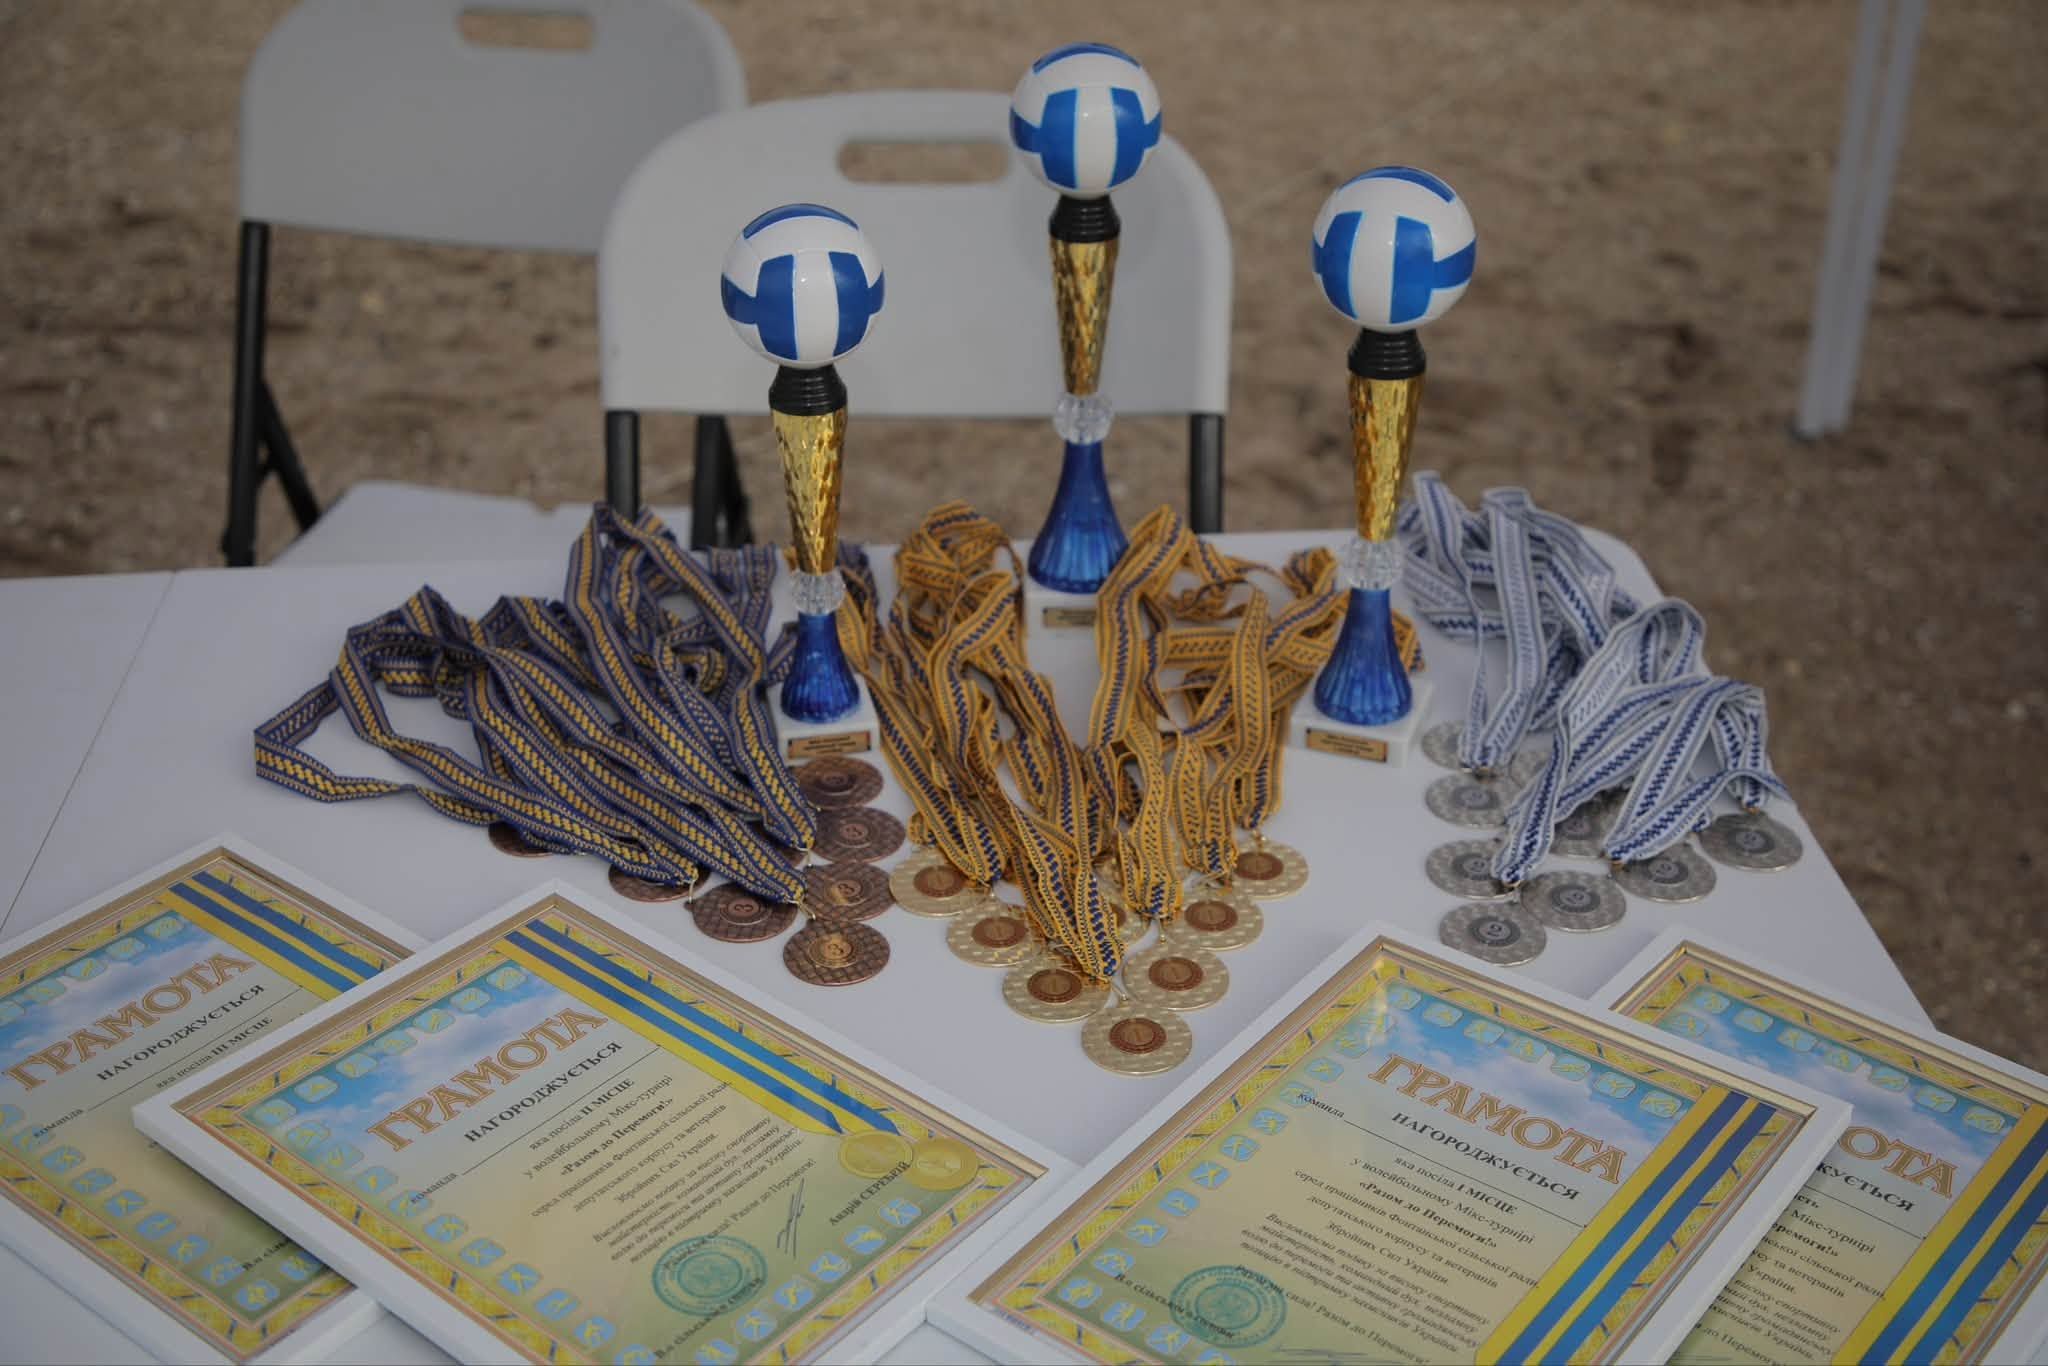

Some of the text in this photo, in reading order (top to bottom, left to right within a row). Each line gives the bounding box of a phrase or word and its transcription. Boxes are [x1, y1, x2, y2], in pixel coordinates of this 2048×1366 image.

[5, 953, 258, 1091] ГРАМОТА
[96, 985, 264, 1080] НАГОРОДЖУЄТЬСЯ
[156, 1017, 272, 1088] яка посіла III МІСЦЕ
[369, 1007, 606, 1151] ГРАМОТА
[464, 1042, 622, 1142] НАГОРОДЖУЄТЬСЯ
[529, 1079, 634, 1150] яка посіла II МІСЦЕ
[1297, 1093, 1344, 1118] команда
[1369, 1054, 1628, 1185] ГРАМОТА
[32, 1109, 84, 1138] команда
[520, 1075, 672, 1178] у волейбольному Мікс-турнірі
[561, 1098, 672, 1175] «Разом до Перемоги!»
[1392, 1112, 1580, 1200] НАГОРОДЖУЄТЬСЯ
[409, 1173, 458, 1204] команда
[1295, 1170, 1324, 1188] серед
[1324, 1184, 1387, 1216] працівників
[1388, 1214, 1457, 1248] Фонтанської
[1457, 1247, 1511, 1273] сільської
[1349, 1157, 1535, 1244] у волейбольному Мікс-турнірі
[1359, 1182, 1496, 1248] «Разом до Перемоги!»
[1394, 1157, 1415, 1170] яка
[1416, 1168, 1455, 1188] посіла
[1465, 1188, 1518, 1214] МІСЦЕ
[1306, 1195, 1498, 1288] депутатського корпусу та ветеранів
[1770, 1221, 1838, 1256] еремоги!»
[1789, 1209, 1876, 1254] Мікс-турнірі
